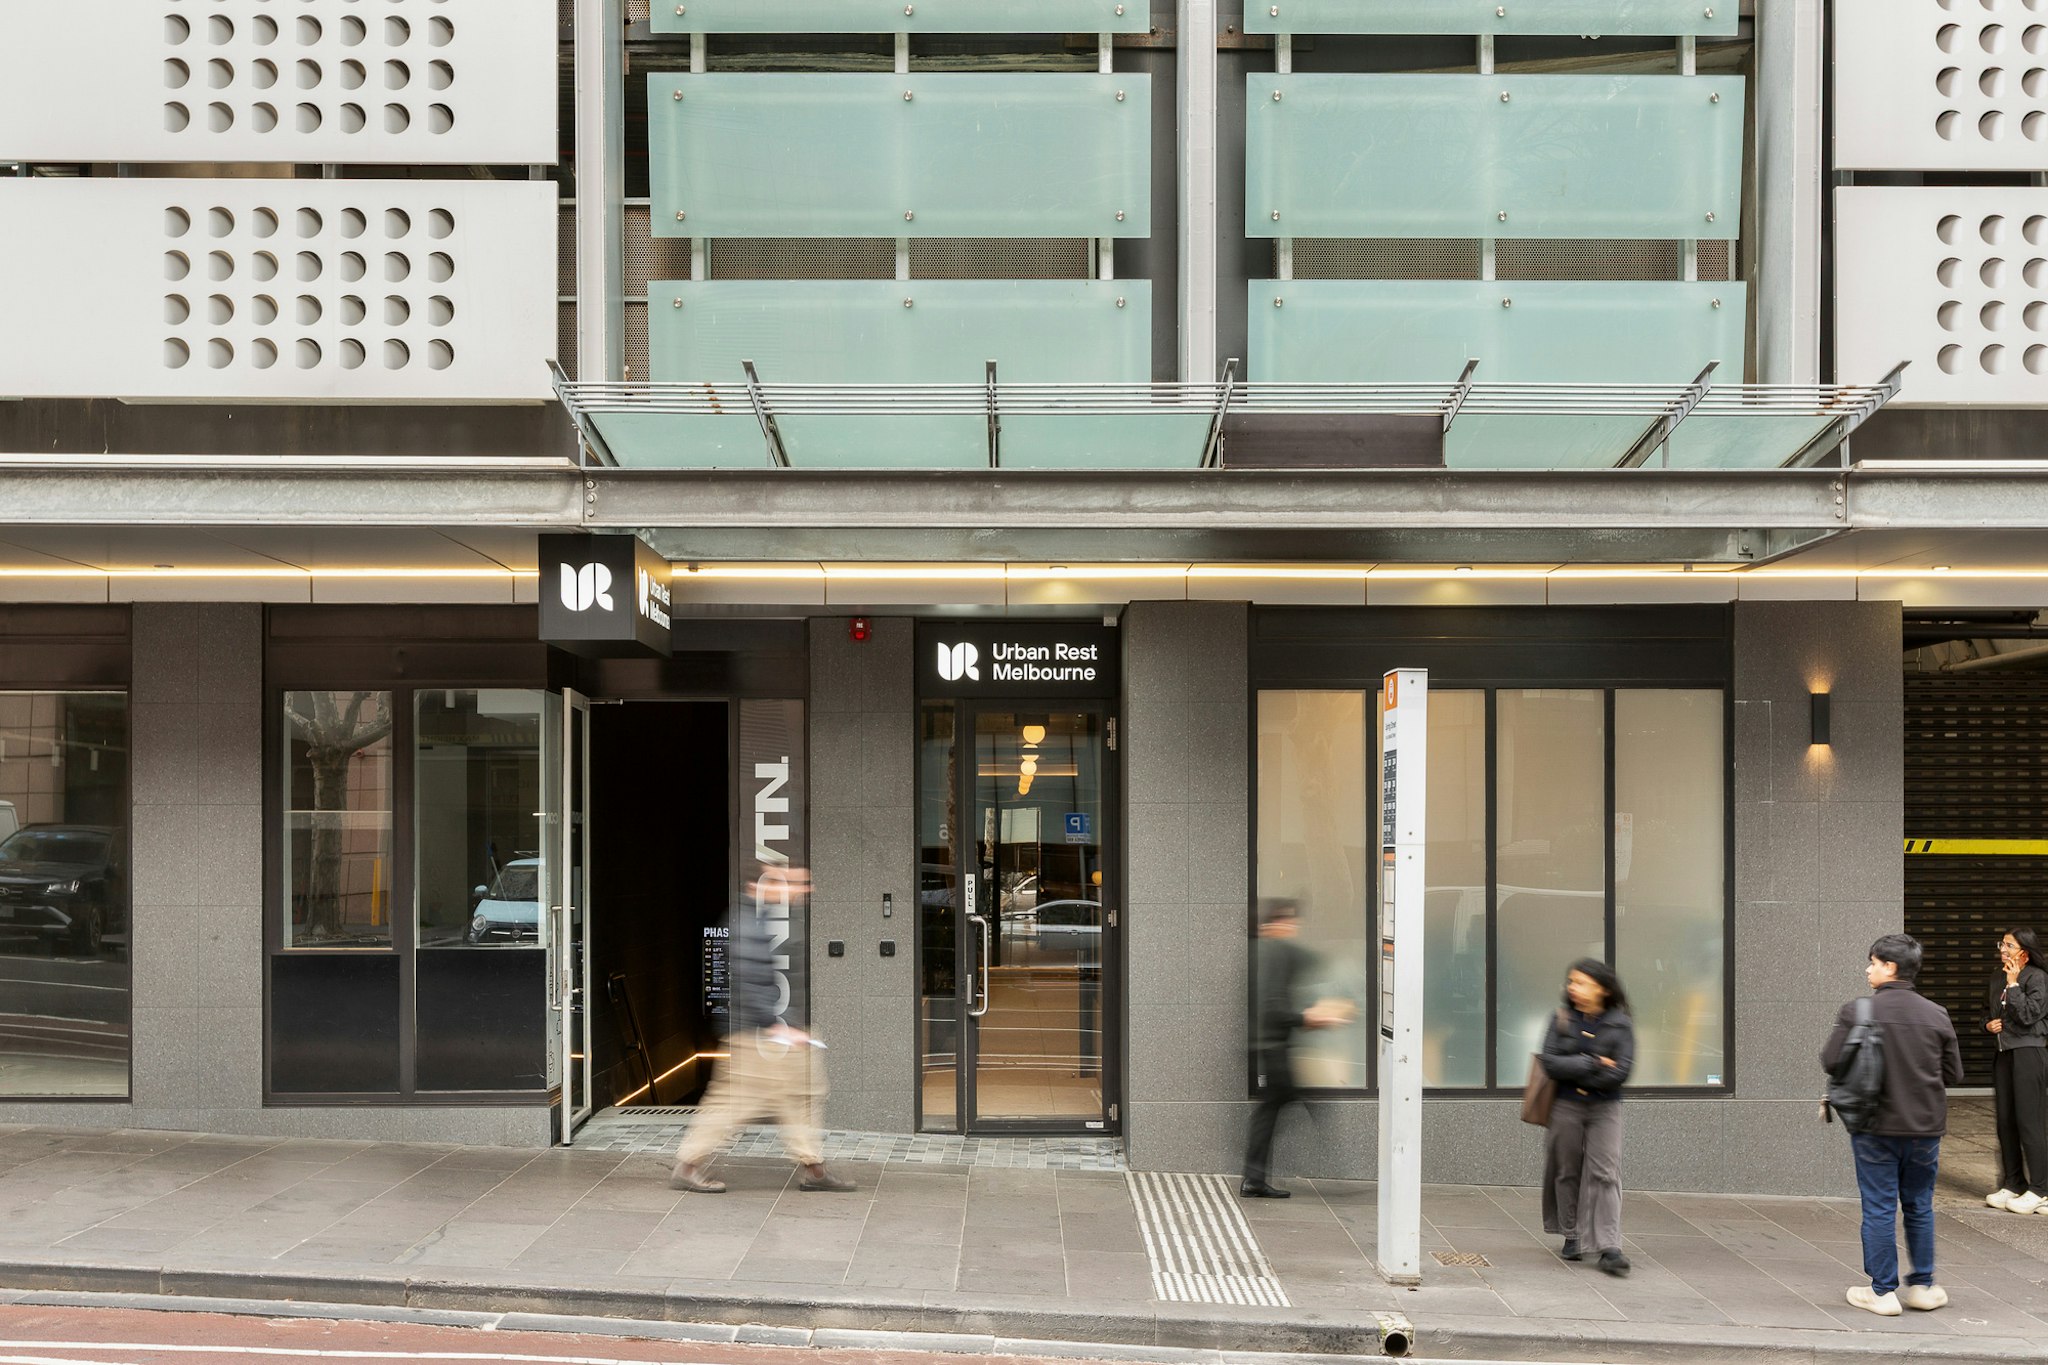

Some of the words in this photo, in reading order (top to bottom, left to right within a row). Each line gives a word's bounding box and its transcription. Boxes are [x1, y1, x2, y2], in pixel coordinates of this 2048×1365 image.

[992, 642, 1050, 661] Urban
[1055, 643, 1098, 661] Rest
[992, 663, 1096, 681] Melbourne
